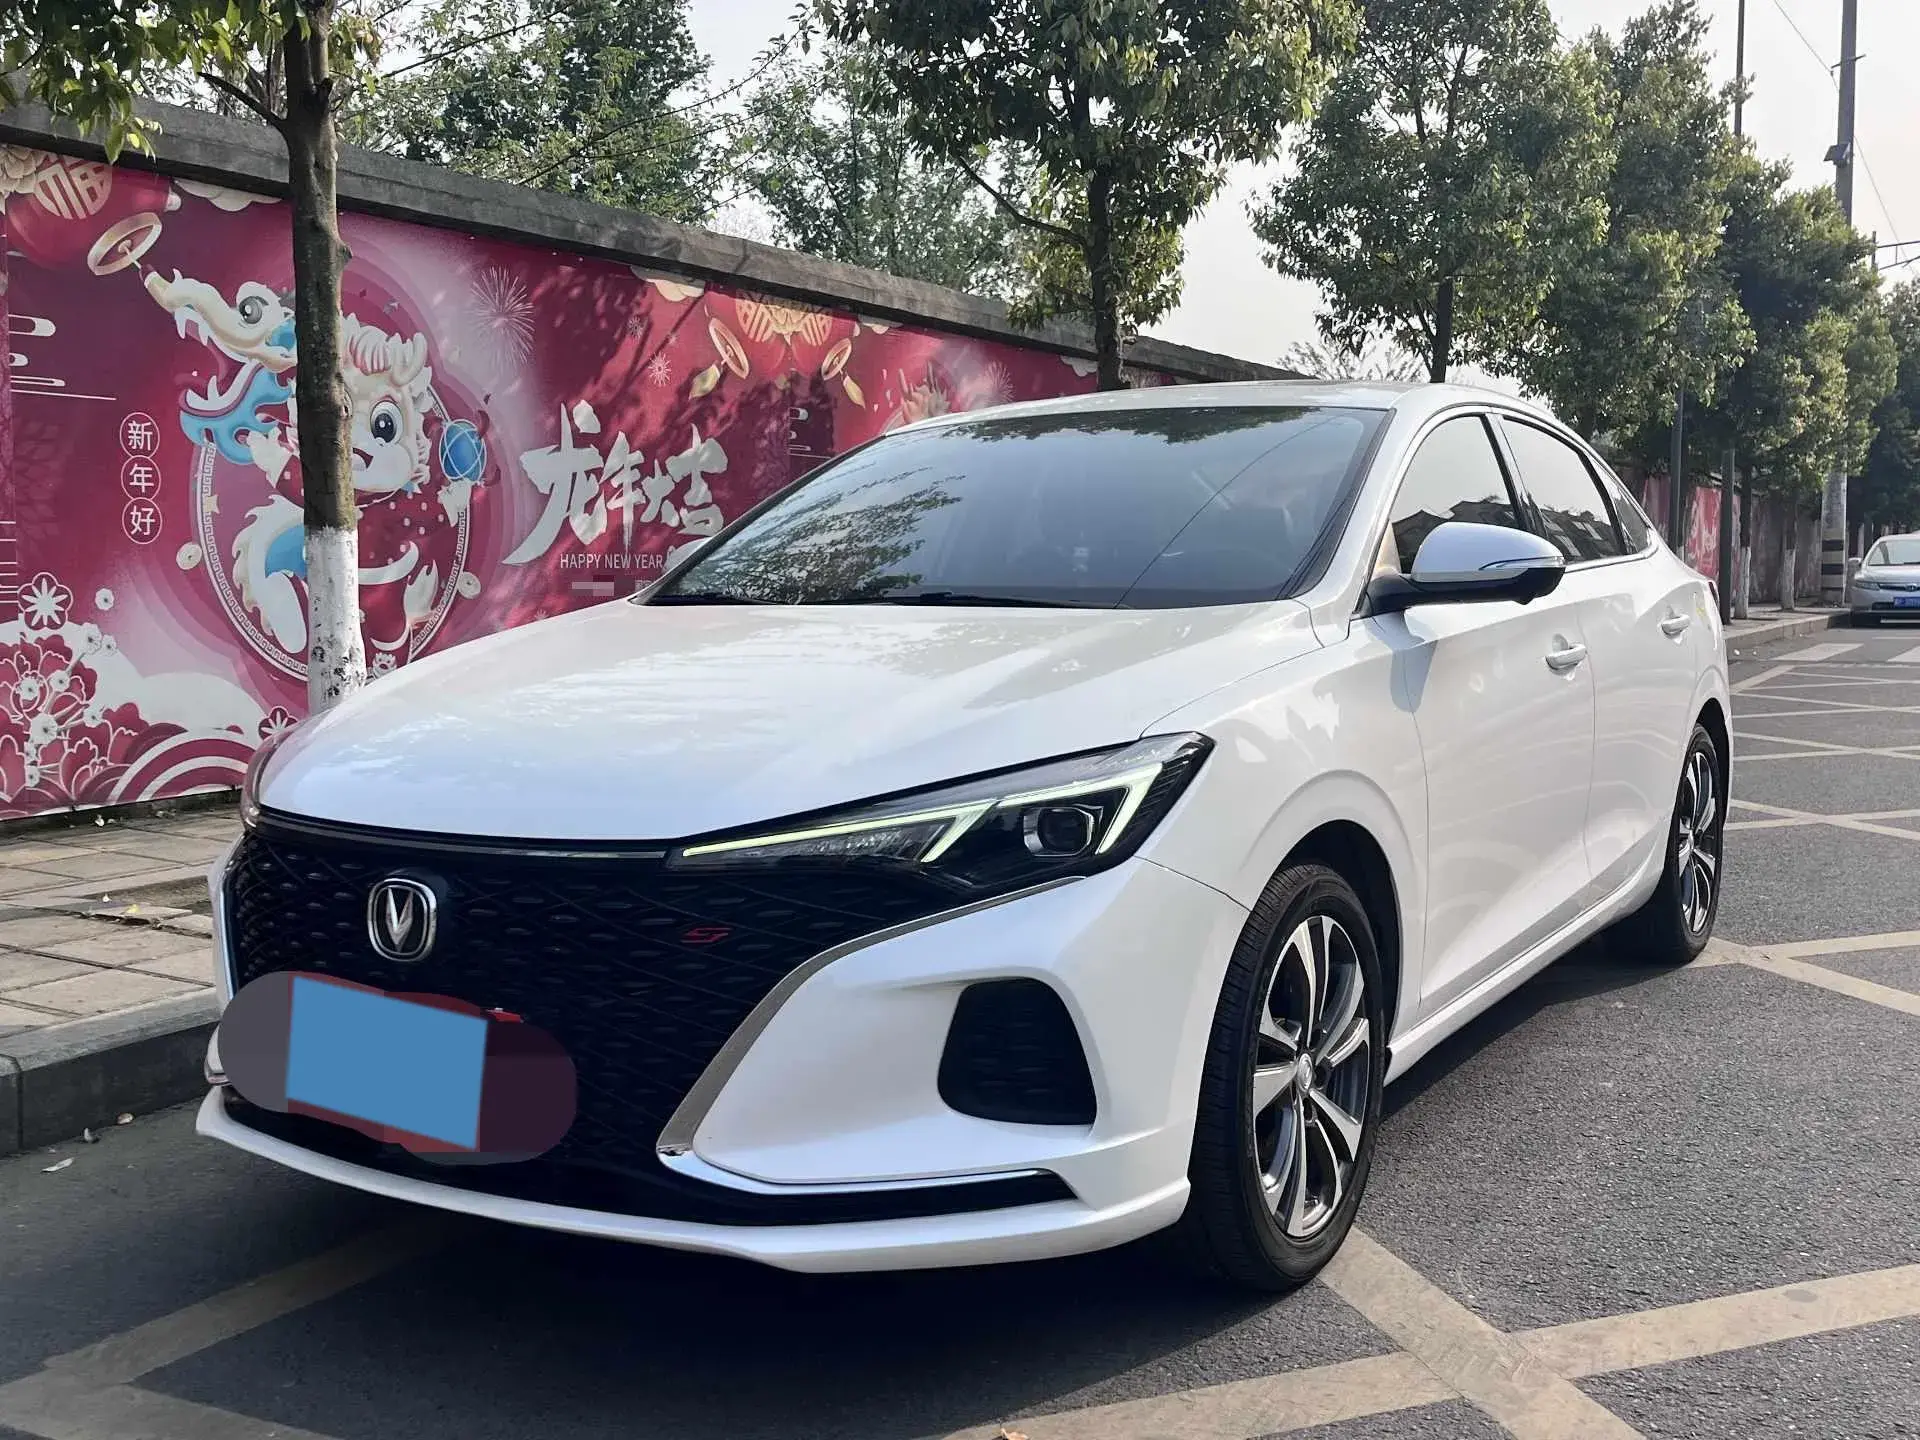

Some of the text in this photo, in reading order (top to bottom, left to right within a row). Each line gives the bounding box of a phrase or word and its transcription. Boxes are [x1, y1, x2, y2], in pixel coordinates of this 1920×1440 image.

[127, 421, 156, 534] 新年好
[502, 400, 728, 564] 龙年大吉
[560, 554, 663, 569] HAPPY NEW YEAR
